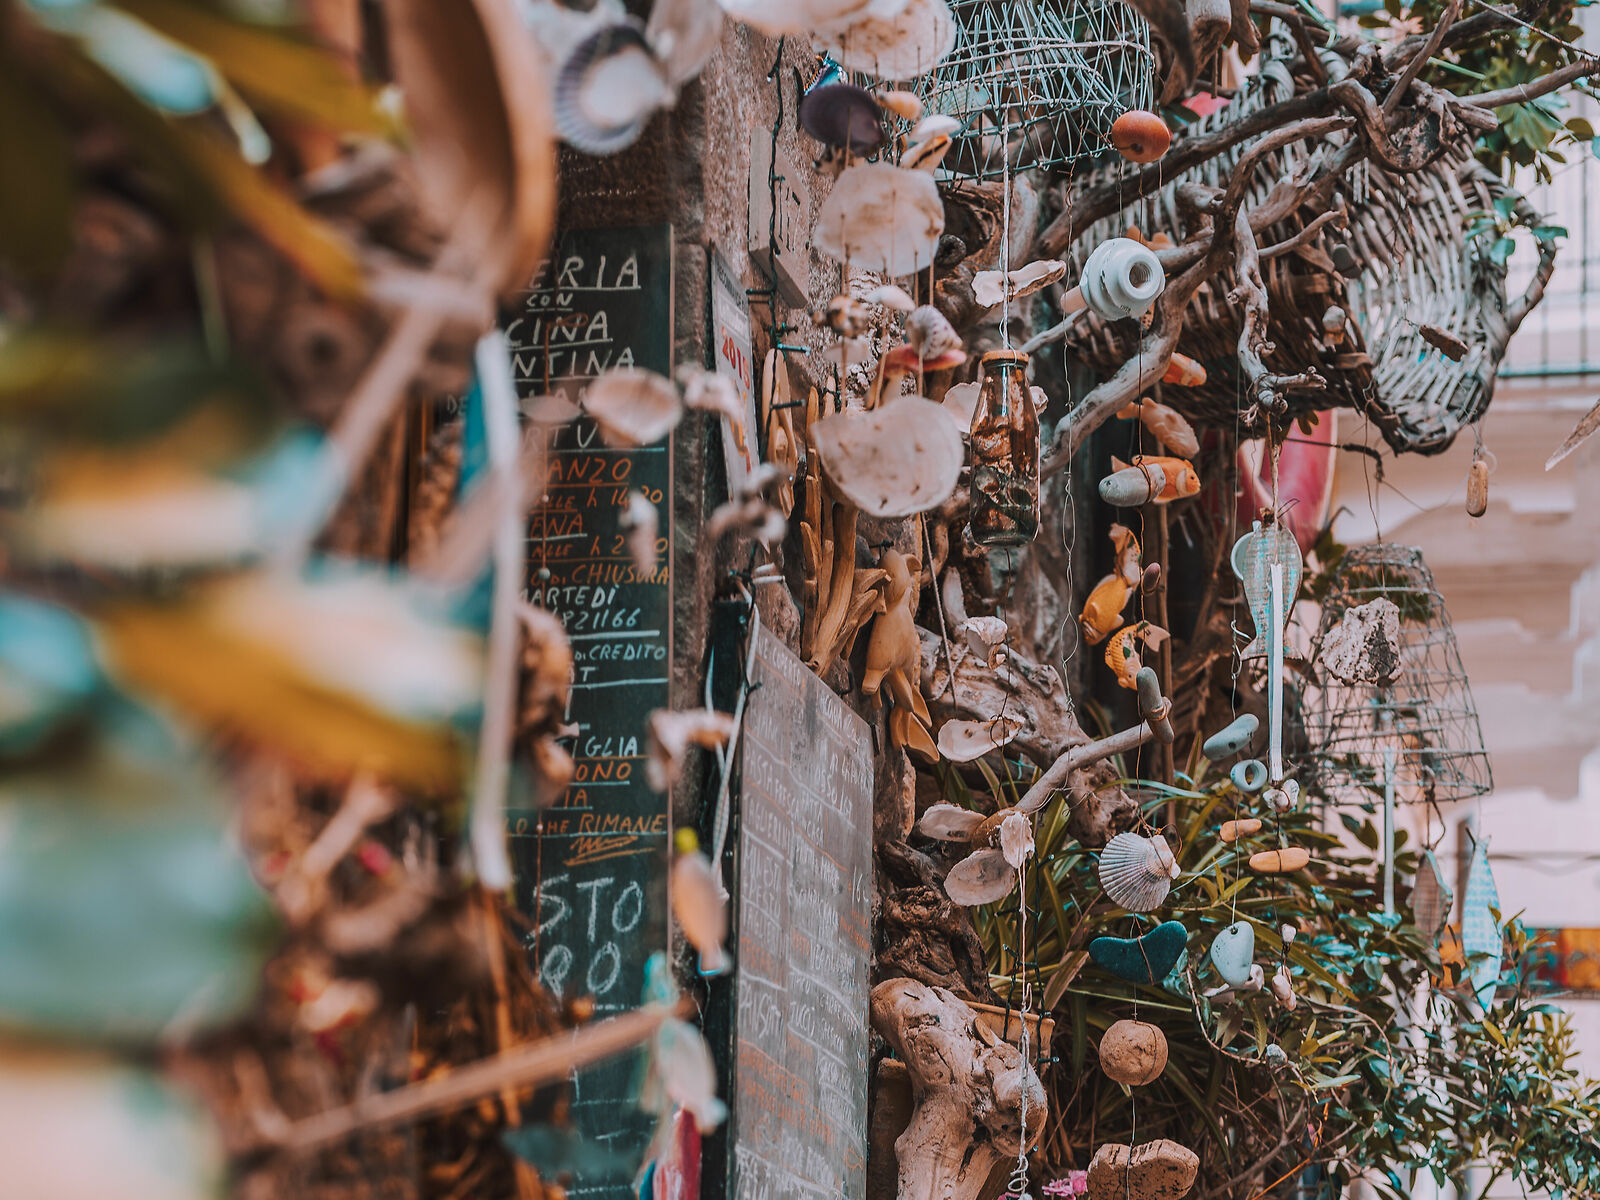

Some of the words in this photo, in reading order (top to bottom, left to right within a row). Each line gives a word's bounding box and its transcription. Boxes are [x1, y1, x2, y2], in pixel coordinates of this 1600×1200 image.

[529, 256, 639, 289] ERIA
[527, 292, 573, 307] CON
[505, 311, 609, 344] CINA
[511, 347, 635, 377] NTINA
[528, 513, 584, 542] ENA
[589, 643, 666, 661] CREDITO
[745, 740, 772, 795] PASTA
[579, 813, 667, 835] RIMANE
[526, 874, 643, 949] STO
